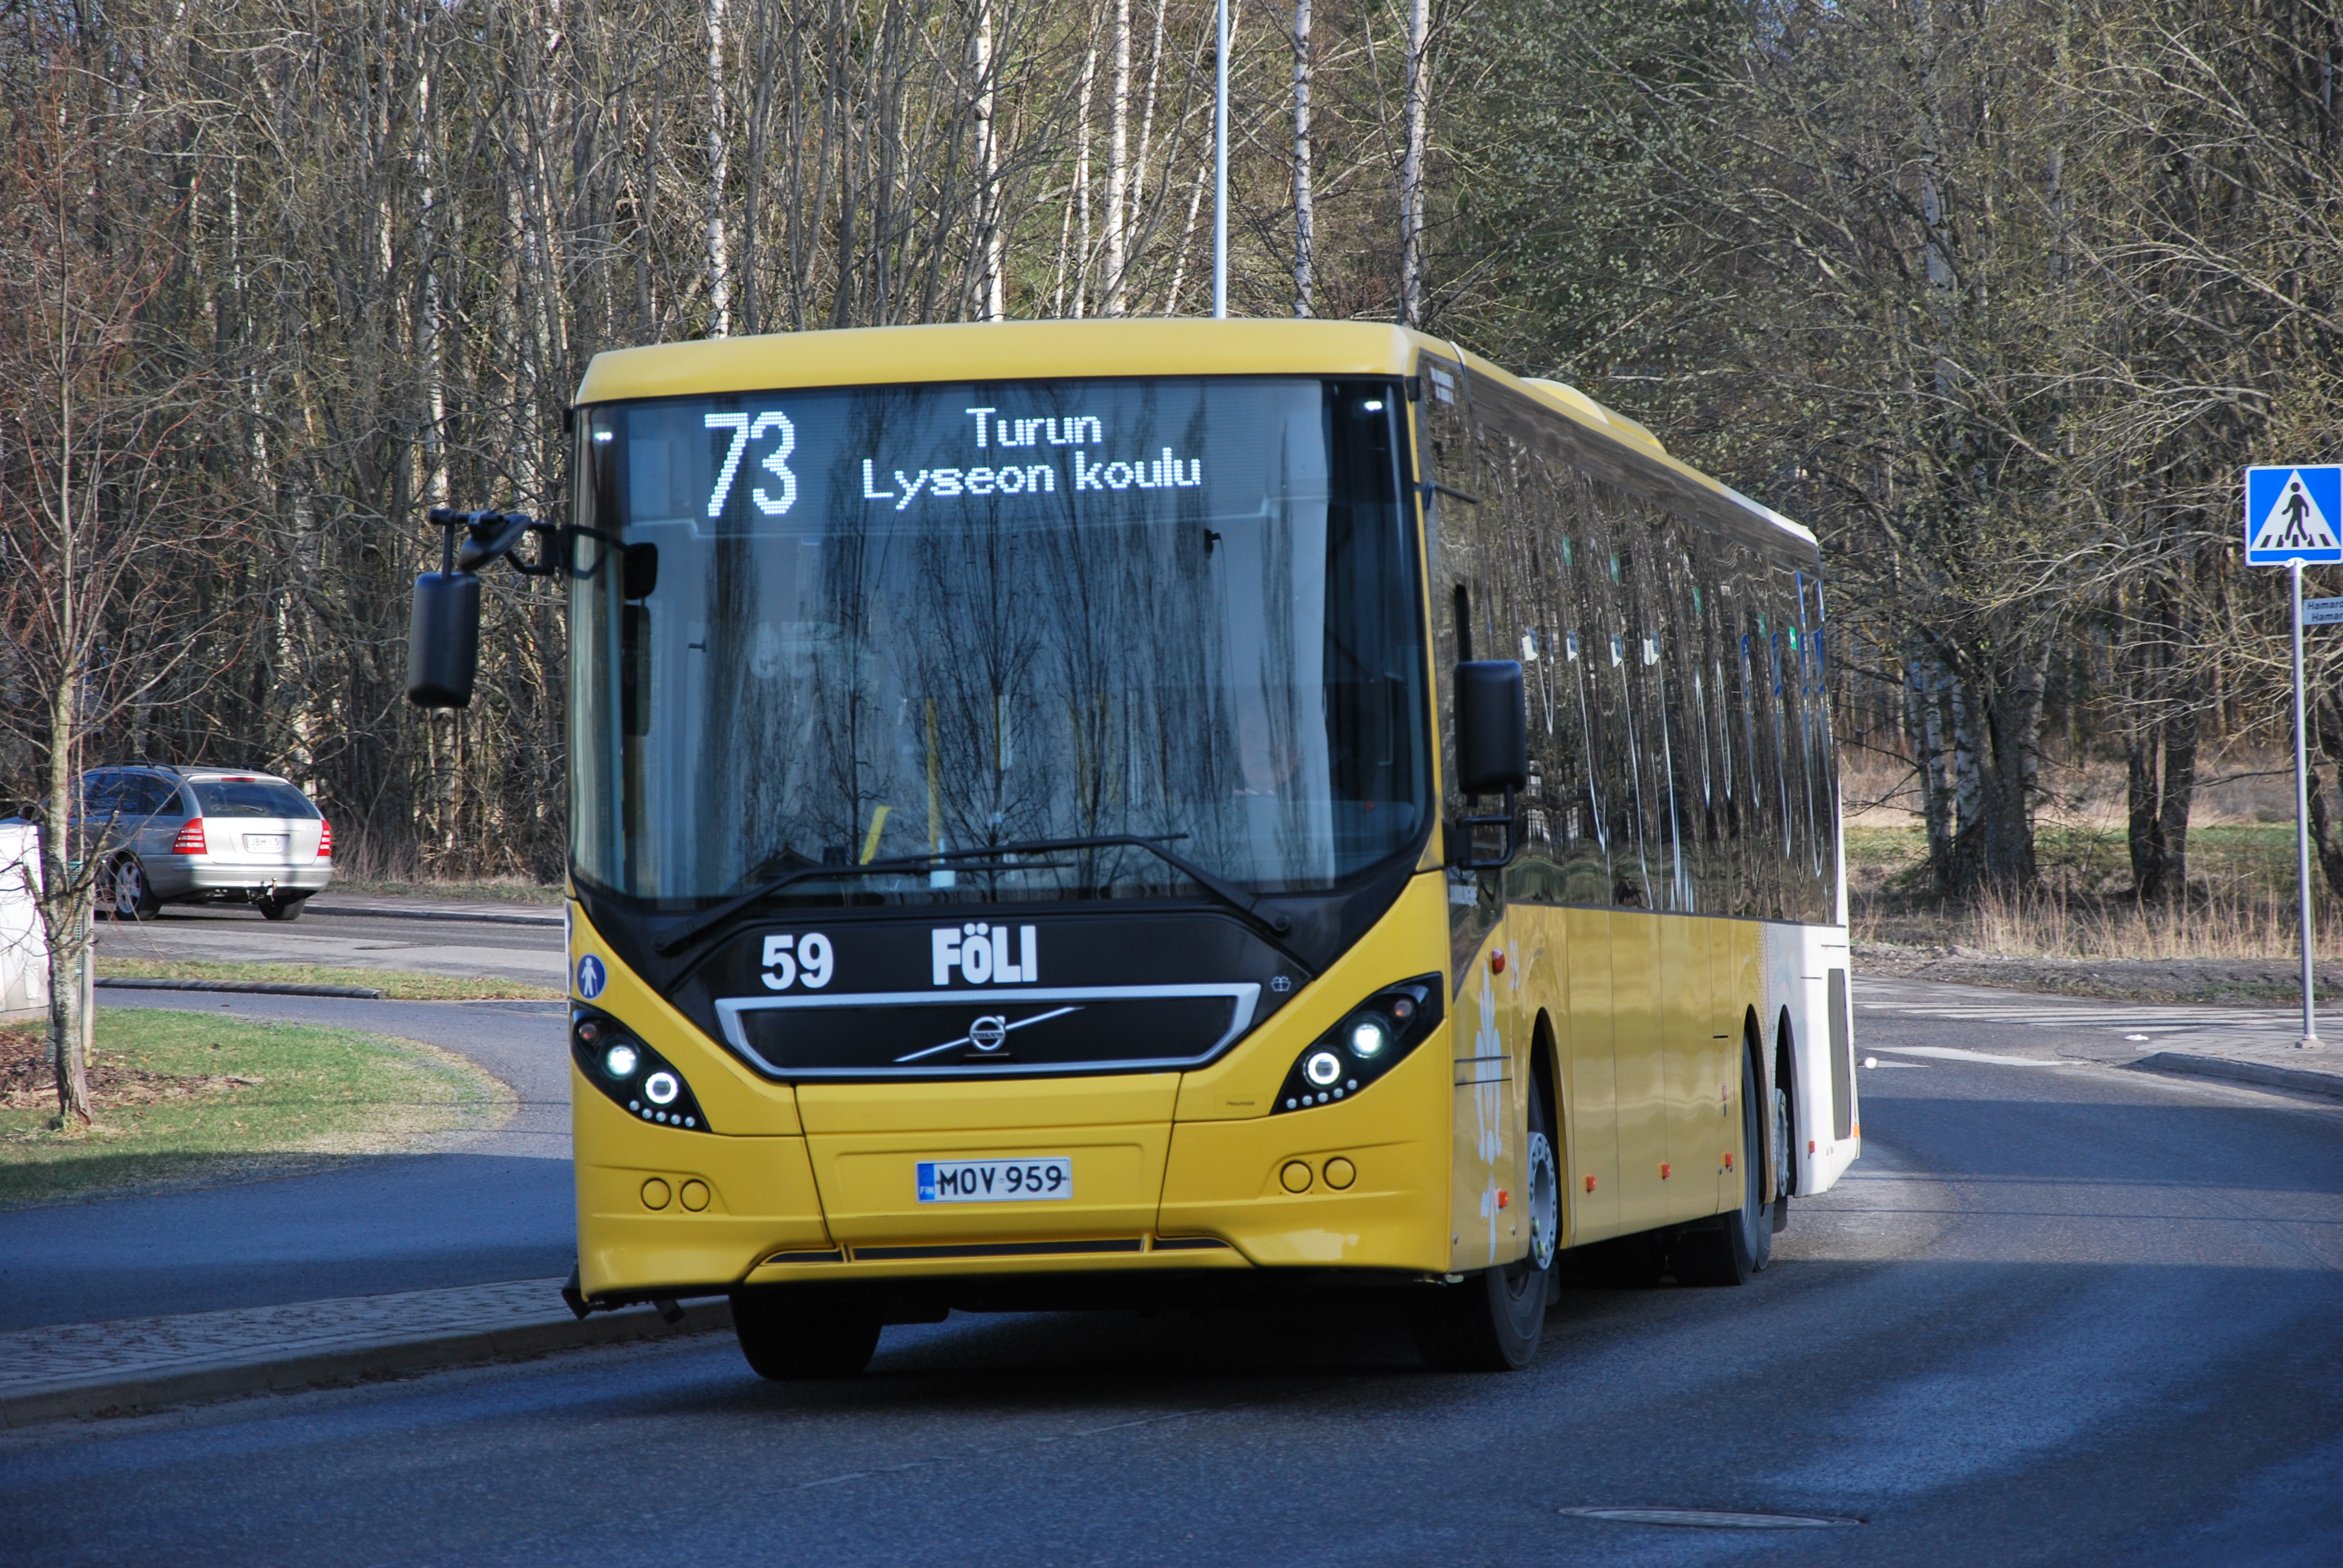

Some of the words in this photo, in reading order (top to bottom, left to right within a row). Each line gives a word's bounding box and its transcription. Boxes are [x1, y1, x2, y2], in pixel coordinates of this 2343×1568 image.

[965, 407, 1102, 448] Turun
[704, 411, 797, 517] 73
[863, 458, 1055, 511] Lyseon
[1075, 447, 1201, 490] koulu
[761, 933, 833, 990] 59
[932, 923, 1037, 985] FÖLI
[939, 1167, 996, 1196] MOV
[1005, 1165, 1063, 1194] 959
